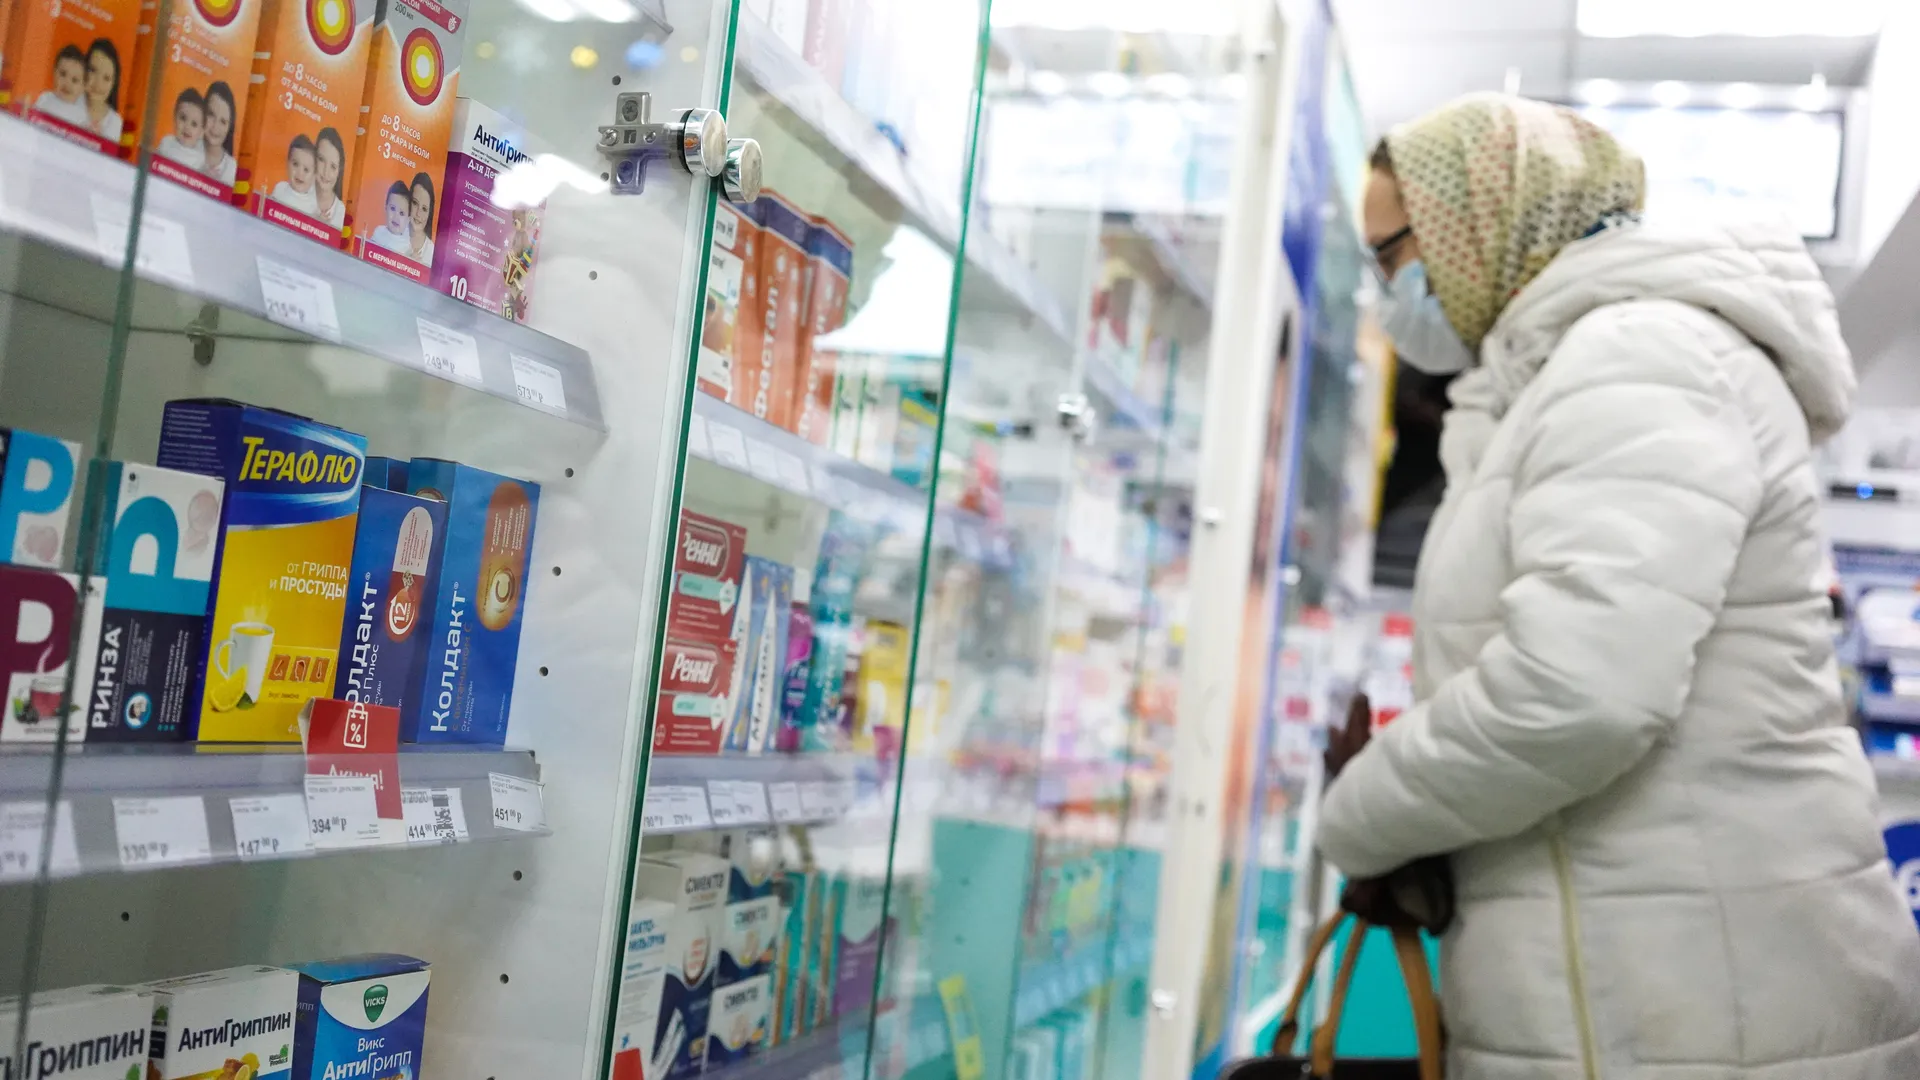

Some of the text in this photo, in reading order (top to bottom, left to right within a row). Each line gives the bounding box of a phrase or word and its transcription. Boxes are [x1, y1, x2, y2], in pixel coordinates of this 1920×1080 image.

[295, 63, 303, 81] 8
[305, 73, 328, 92] ЧАСОВ
[284, 91, 293, 110] 3
[318, 97, 338, 114] БОЛИ
[382, 114, 421, 141] ДО 8 ЧАСОВ
[380, 128, 431, 160] ОТ ЖАРА И БОЛИ
[383, 142, 391, 159] 3
[467, 159, 484, 174] Для
[368, 250, 421, 278] С МЕРНЫМ ШПРИЦЕМ
[450, 274, 468, 301] 10
[301, 561, 348, 581] ГРИППА
[279, 575, 346, 600] ПРОСТУДЫ
[394, 602, 408, 623] 12
[91, 626, 123, 729] РИНЗА
[670, 652, 716, 684] Ренни
[494, 807, 509, 822] 451
[311, 818, 331, 834] 394
[408, 825, 426, 839] 414
[240, 839, 260, 857] 147
[365, 996, 386, 1008] VICKS
[178, 1011, 291, 1052] АнтиГриппин
[357, 1037, 385, 1053] Викс
[322, 1050, 413, 1080] АнтиГрипп
